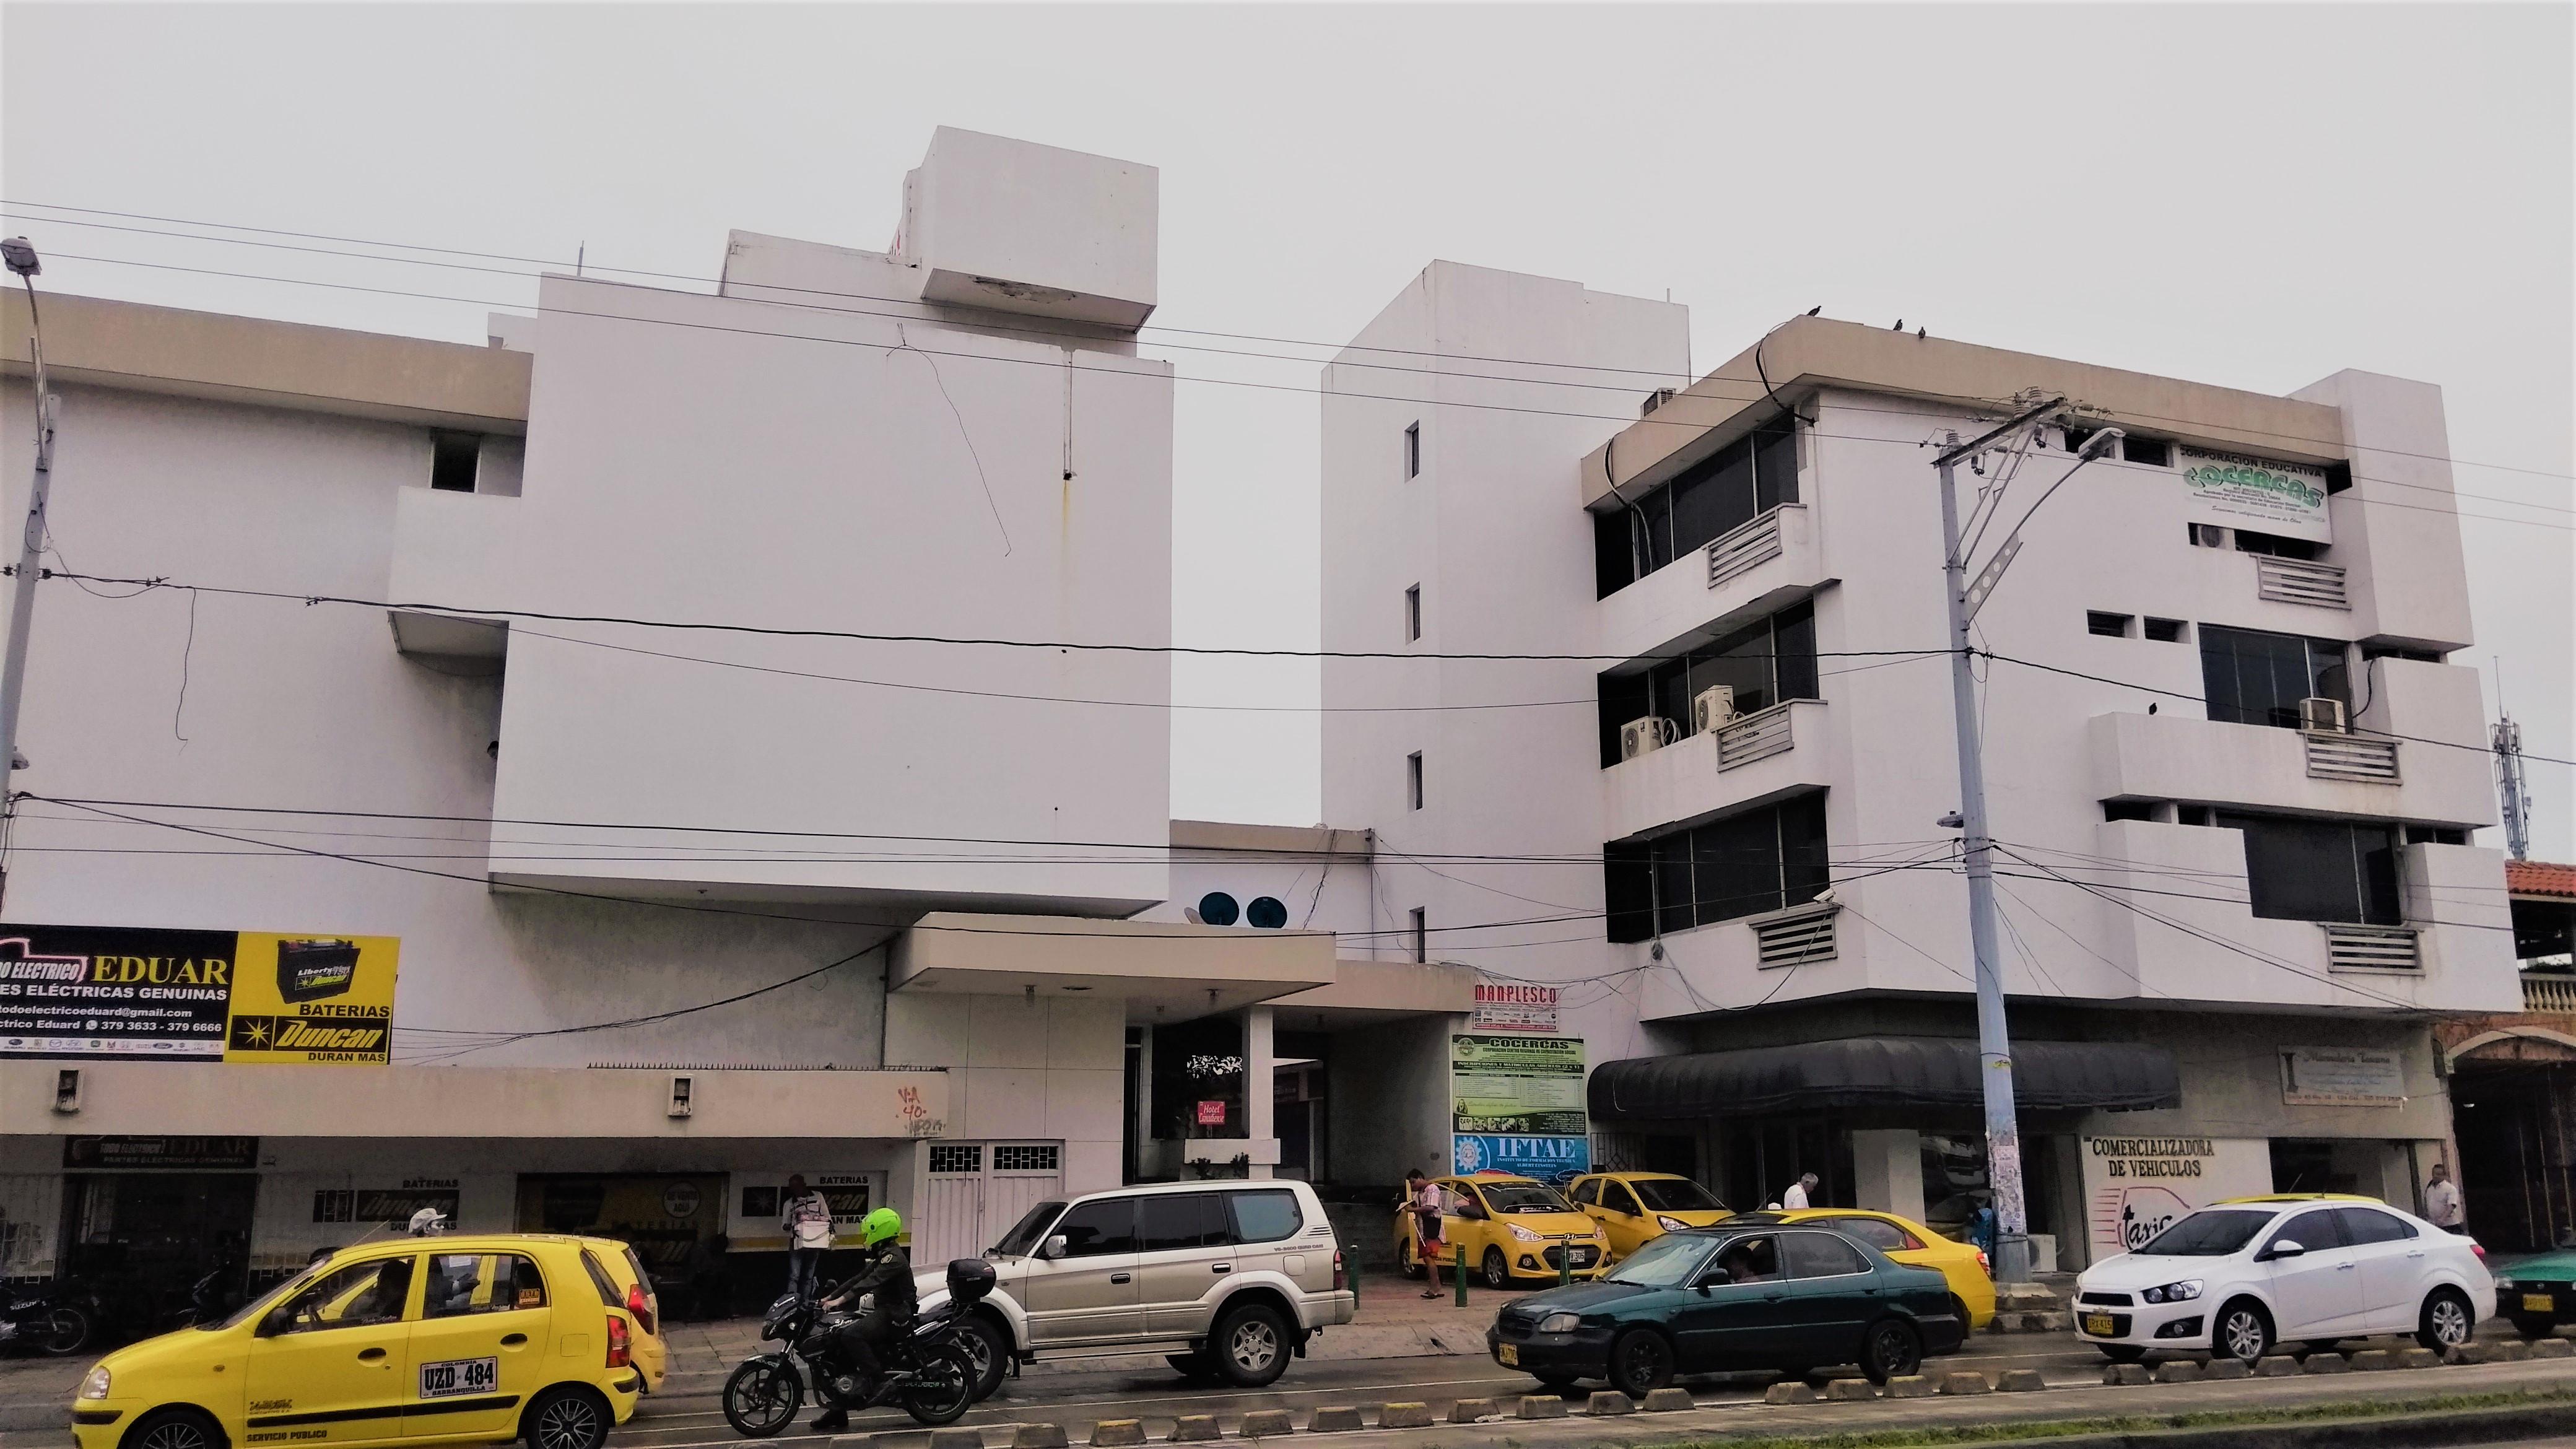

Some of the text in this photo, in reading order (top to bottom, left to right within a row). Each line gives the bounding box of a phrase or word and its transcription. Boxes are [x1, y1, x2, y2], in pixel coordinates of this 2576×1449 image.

[2262, 461, 2322, 477] EDUCATIVA
[2183, 465, 2324, 508] COCERCAS
[0, 961, 80, 981] O ELECTRICO
[91, 955, 229, 985] EDUAR
[298, 967, 333, 976] Liberty
[26, 983, 134, 998] ELÉCTRICAS
[139, 988, 227, 1001] GENUINAS
[1475, 985, 1556, 1003] MANPLESCO
[299, 1004, 389, 1017] BATERIAS
[37, 1020, 80, 1029] Eduard
[101, 1021, 124, 1030] 379
[126, 1022, 157, 1030] 3633
[167, 1022, 189, 1031] 379
[193, 1023, 222, 1032] 6666
[275, 1020, 383, 1048] Duncan
[1490, 1039, 1569, 1049] COCERCAS
[308, 1052, 385, 1061] DURAN MAS
[1203, 1104, 1220, 1113] Hotel
[1497, 1138, 1575, 1158] IFTAE
[2092, 1138, 2214, 1156] COMERCIALIZADORA
[2108, 1159, 2201, 1177] DE VEHICULOS
[402, 1180, 458, 1188] BATERIAS
[425, 1362, 494, 1391] UZD 484
[432, 1386, 486, 1396] BARRANQUILLA
[247, 1432, 287, 1442] SERVICIO
